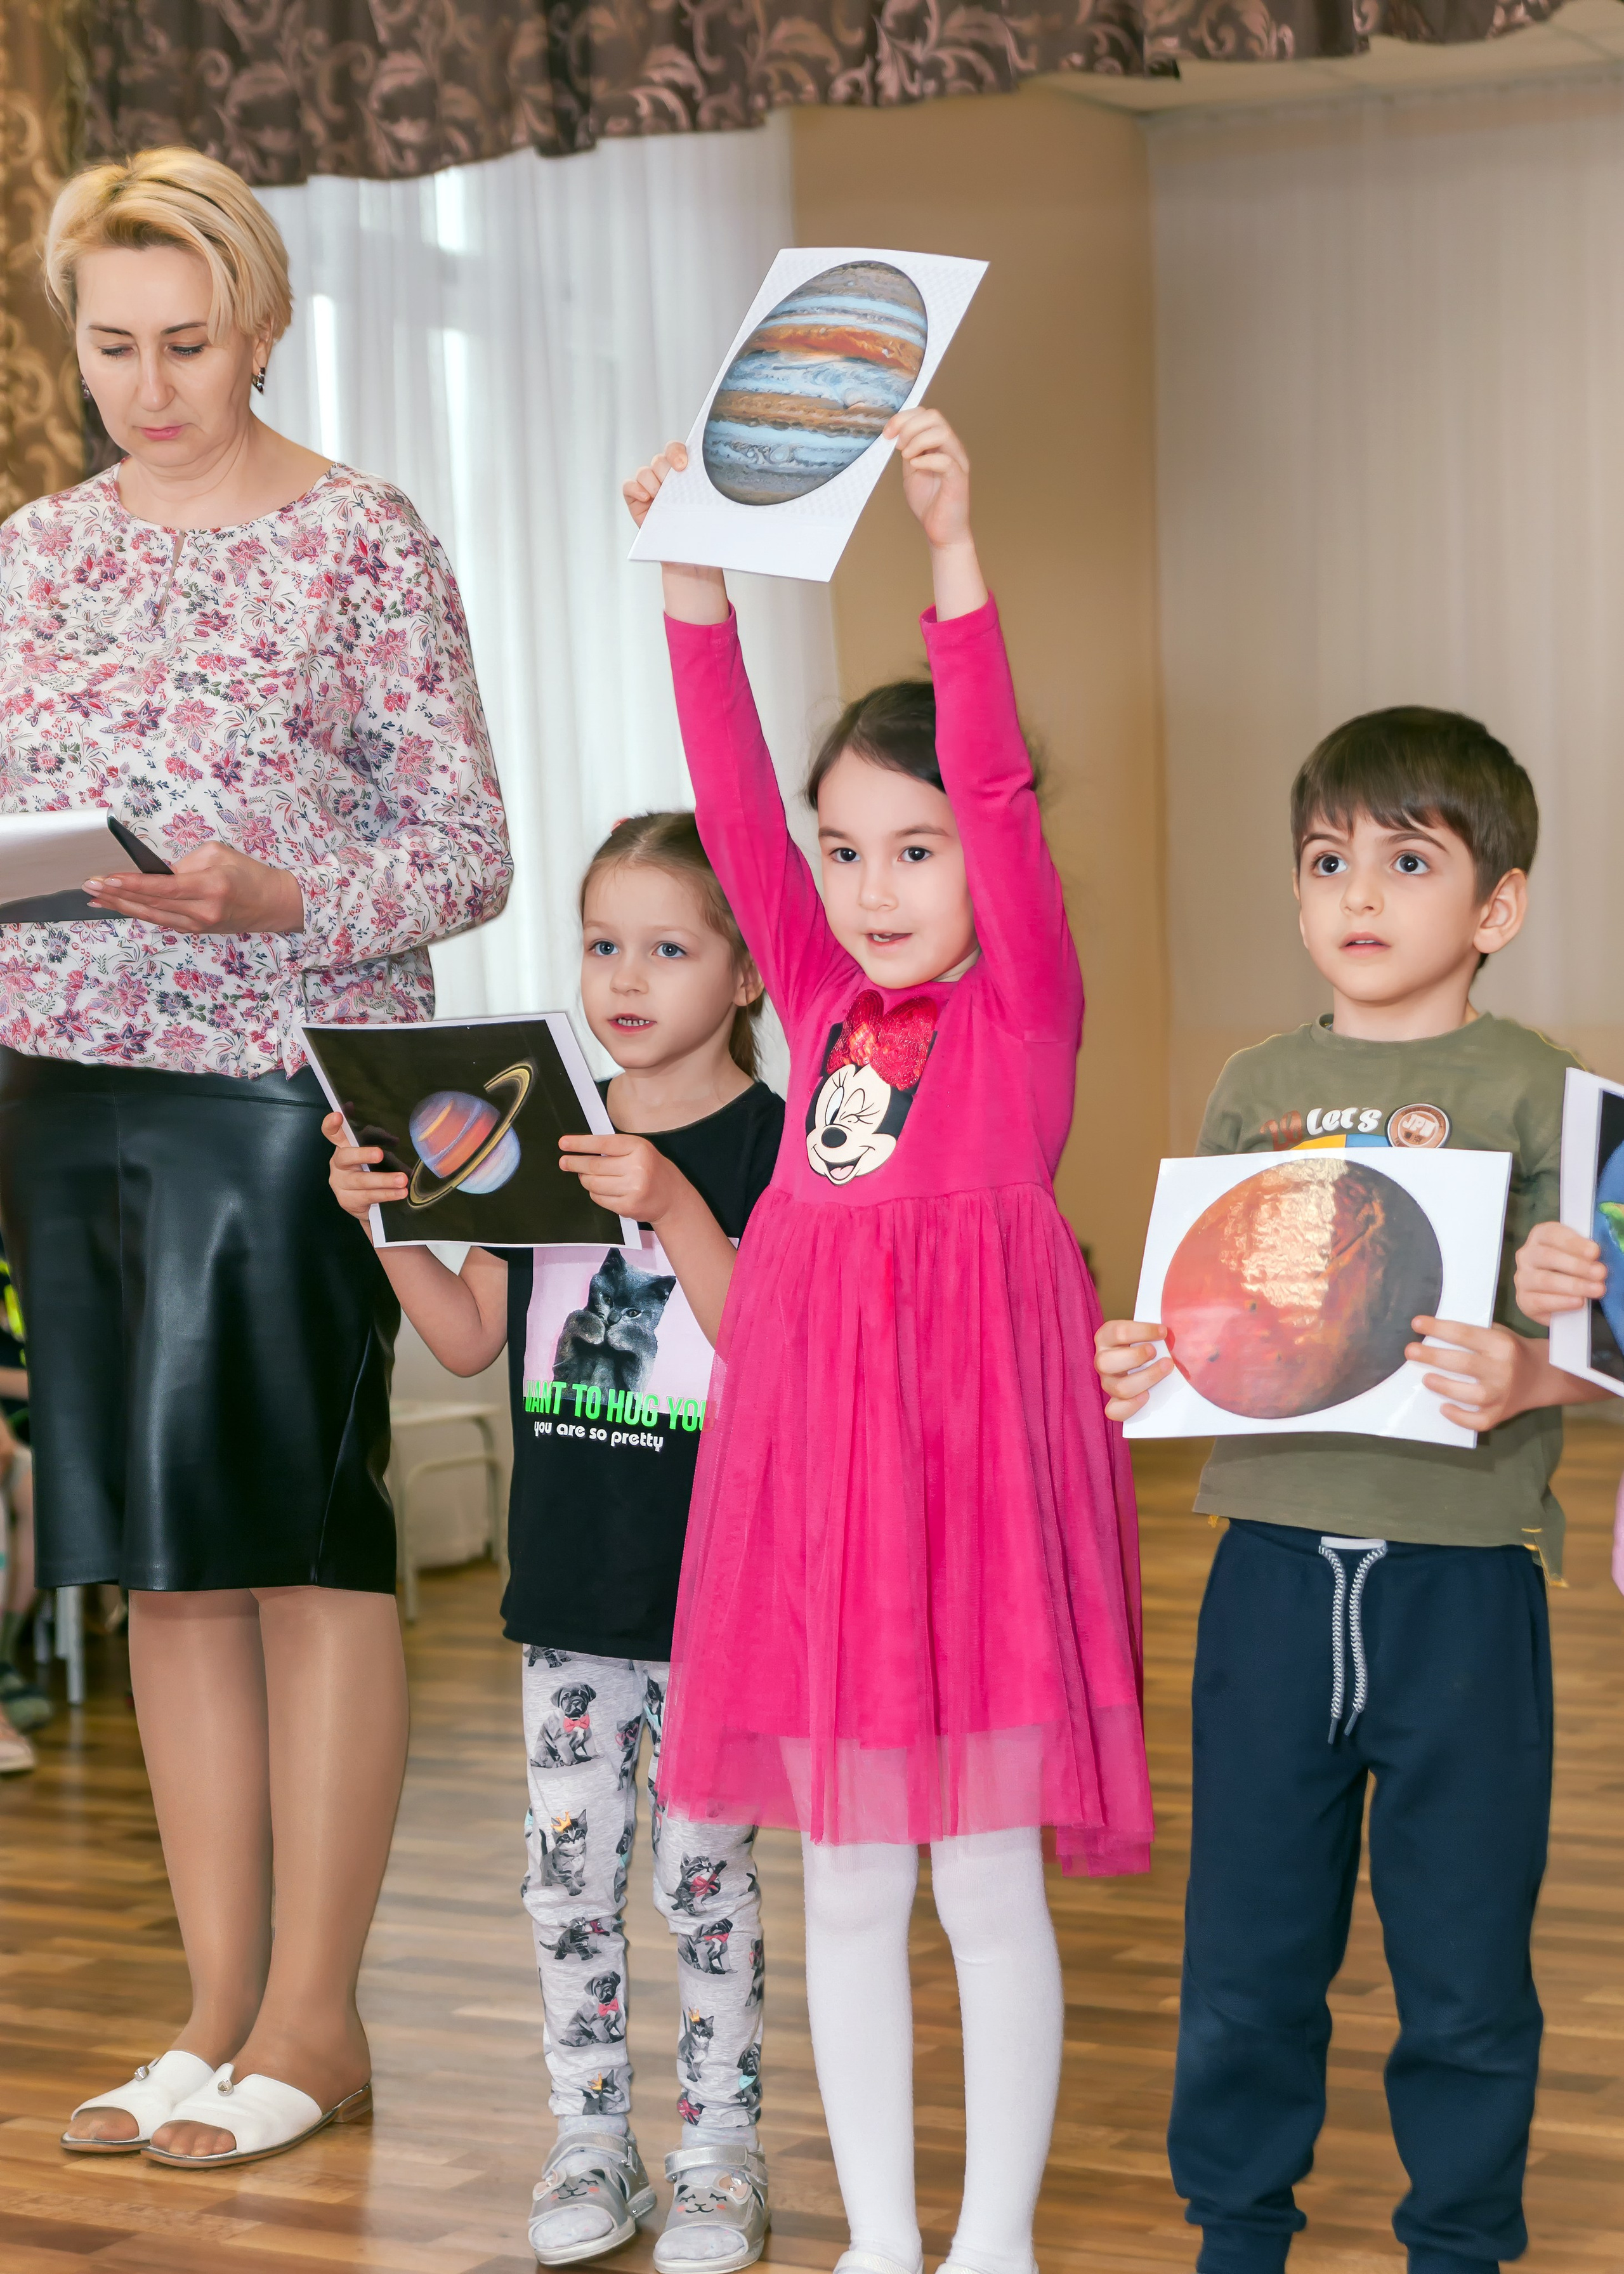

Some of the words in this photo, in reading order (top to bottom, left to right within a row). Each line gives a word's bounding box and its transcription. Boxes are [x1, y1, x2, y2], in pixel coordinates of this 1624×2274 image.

[572, 1383, 601, 1420] TO
[606, 1388, 658, 1427] HUG
[534, 1421, 553, 1437] you
[556, 1423, 586, 1438] are
[589, 1428, 607, 1441] so
[610, 1431, 664, 1452] pretty
